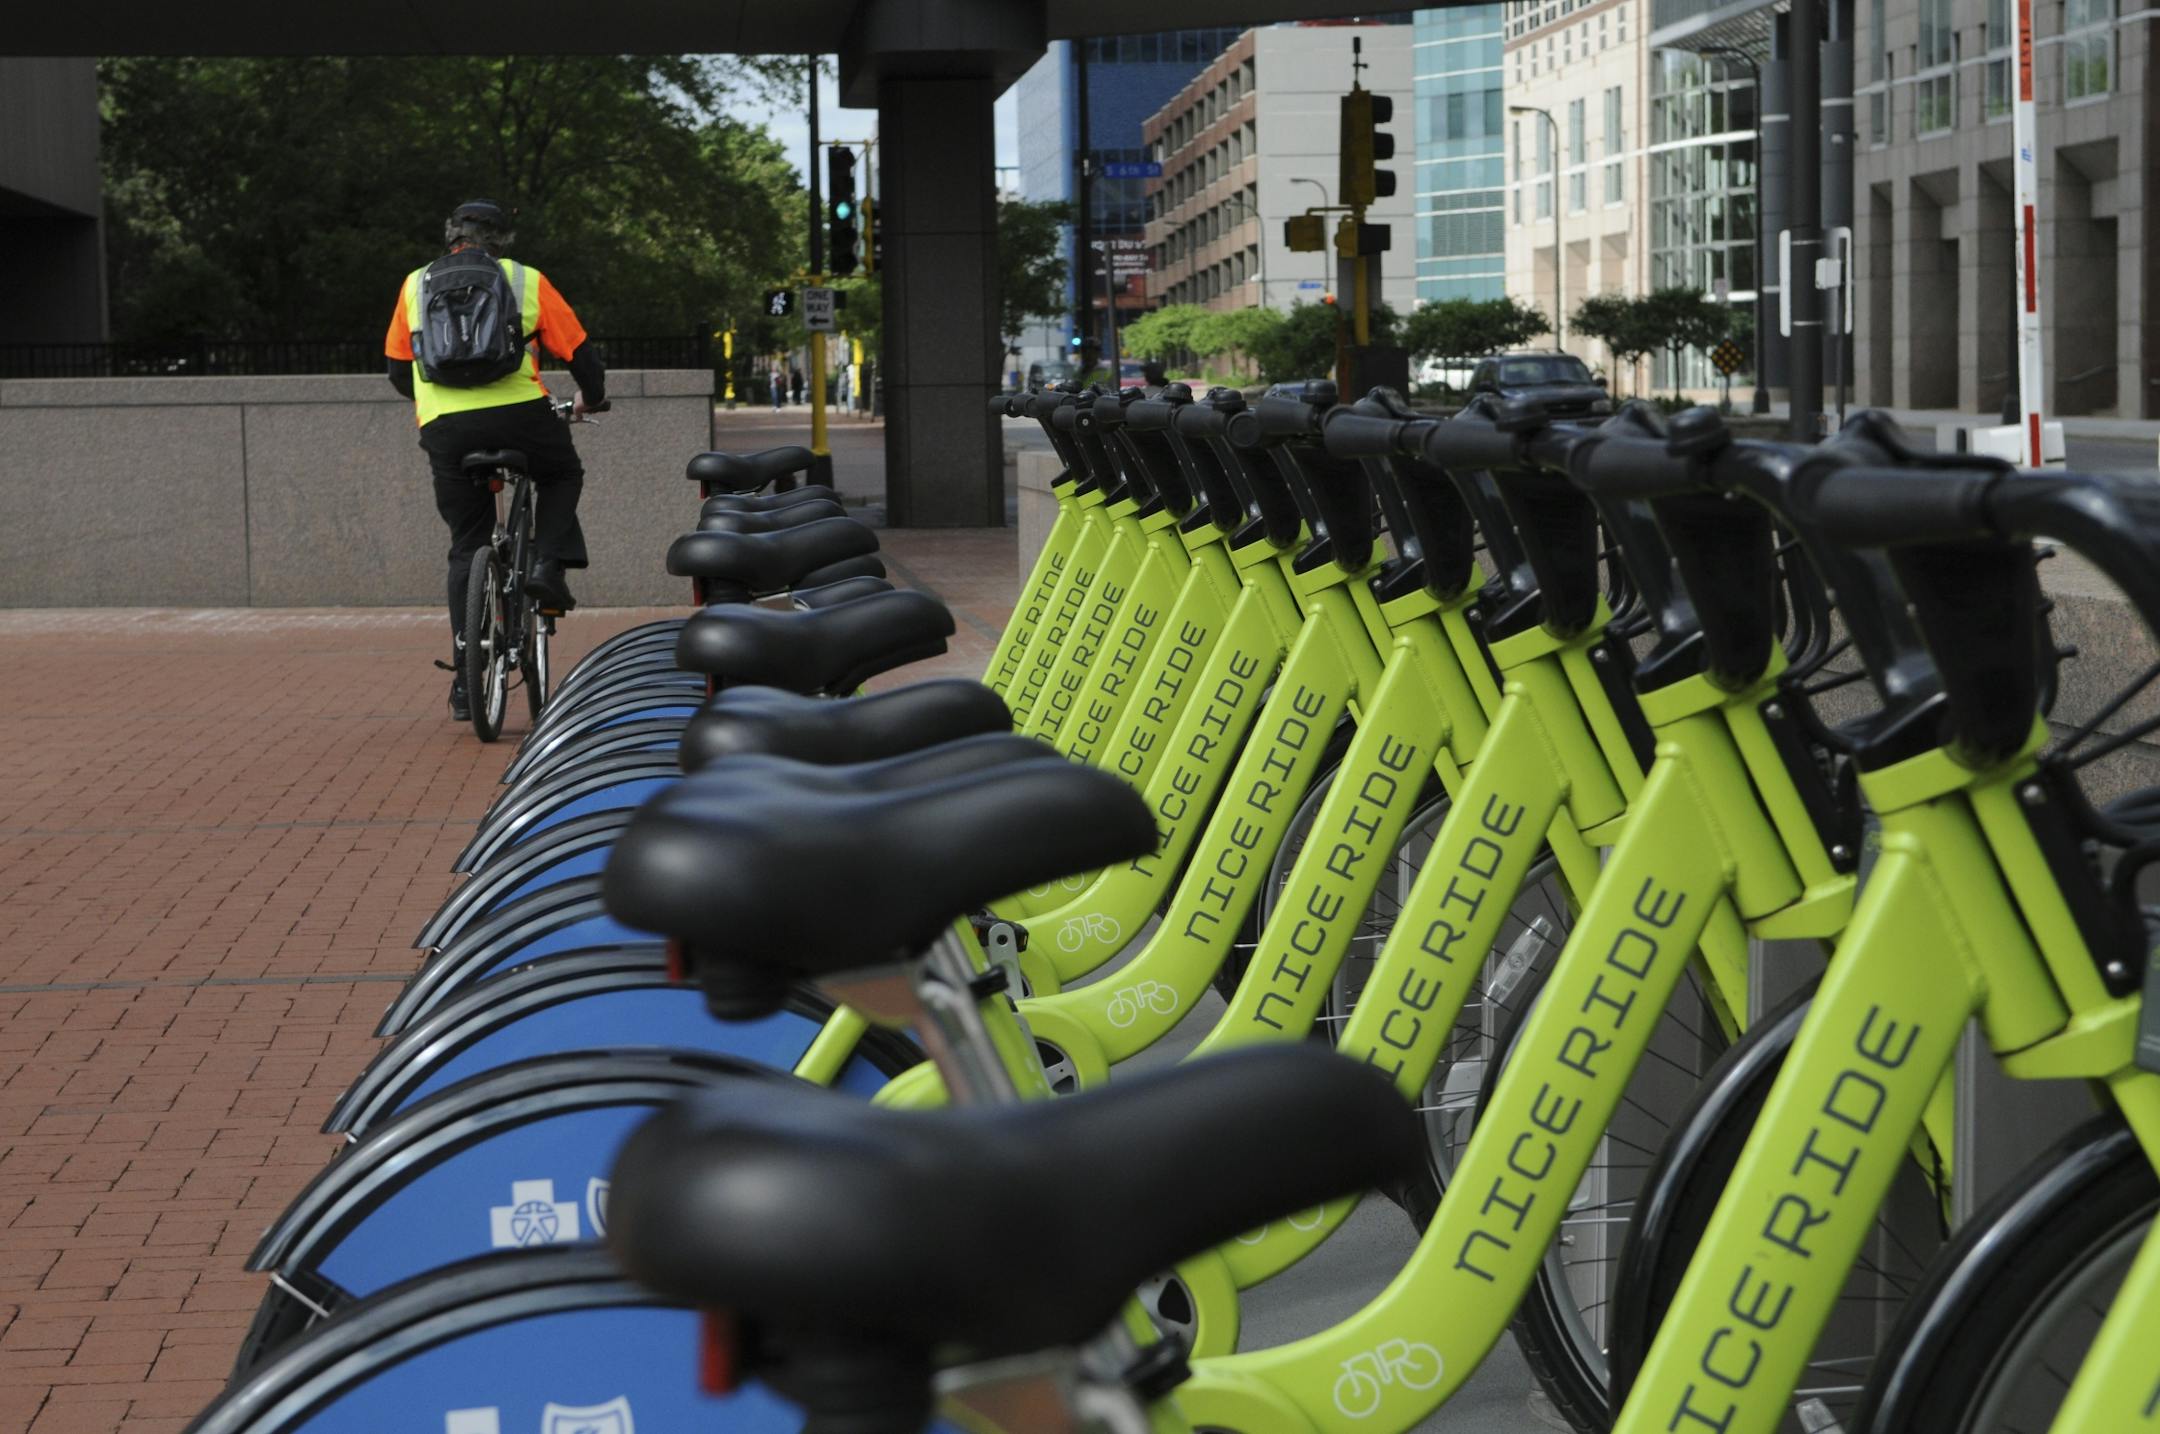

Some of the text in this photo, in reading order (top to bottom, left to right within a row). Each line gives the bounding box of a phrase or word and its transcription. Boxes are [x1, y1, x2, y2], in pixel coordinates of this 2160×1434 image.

[807, 290, 829, 300] ONE
[807, 304, 830, 312] WAY
[1047, 568, 1095, 645] RIDE
[1072, 582, 1125, 667] RIDE
[1067, 603, 1158, 765] ICE RIDE
[1143, 620, 1207, 724] RIDE
[1187, 650, 1259, 764] RIDE
[1246, 685, 1326, 814] RIDE
[1326, 735, 1416, 881] RIDE
[1365, 793, 1526, 1084] ICE RIDE
[1558, 877, 1687, 1079] RIDE
[1669, 1005, 1921, 1434] ICE RIDE
